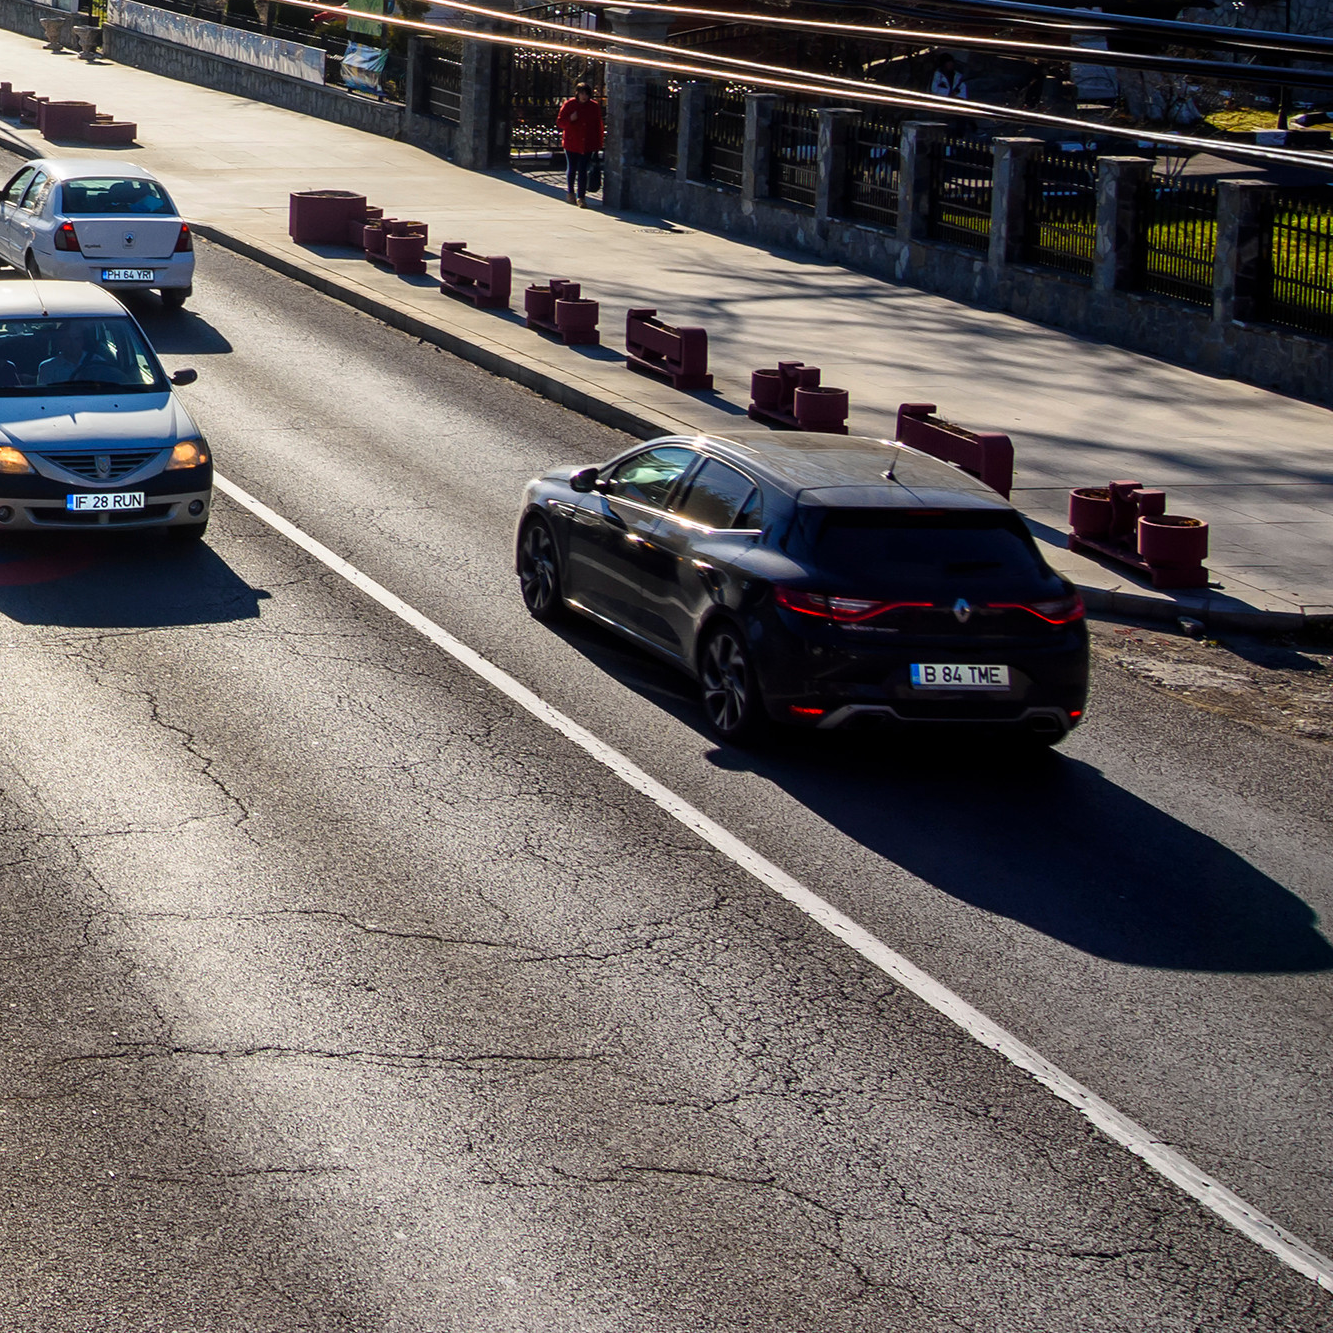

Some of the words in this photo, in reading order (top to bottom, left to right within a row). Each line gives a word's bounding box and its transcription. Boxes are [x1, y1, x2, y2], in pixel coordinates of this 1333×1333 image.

[107, 270, 121, 279] PH
[123, 270, 134, 279] 64
[75, 496, 88, 509] IF
[93, 496, 109, 508] 28
[113, 494, 142, 508] RUN
[924, 666, 936, 683] B
[942, 666, 962, 683] 84
[968, 666, 1002, 684] TME
